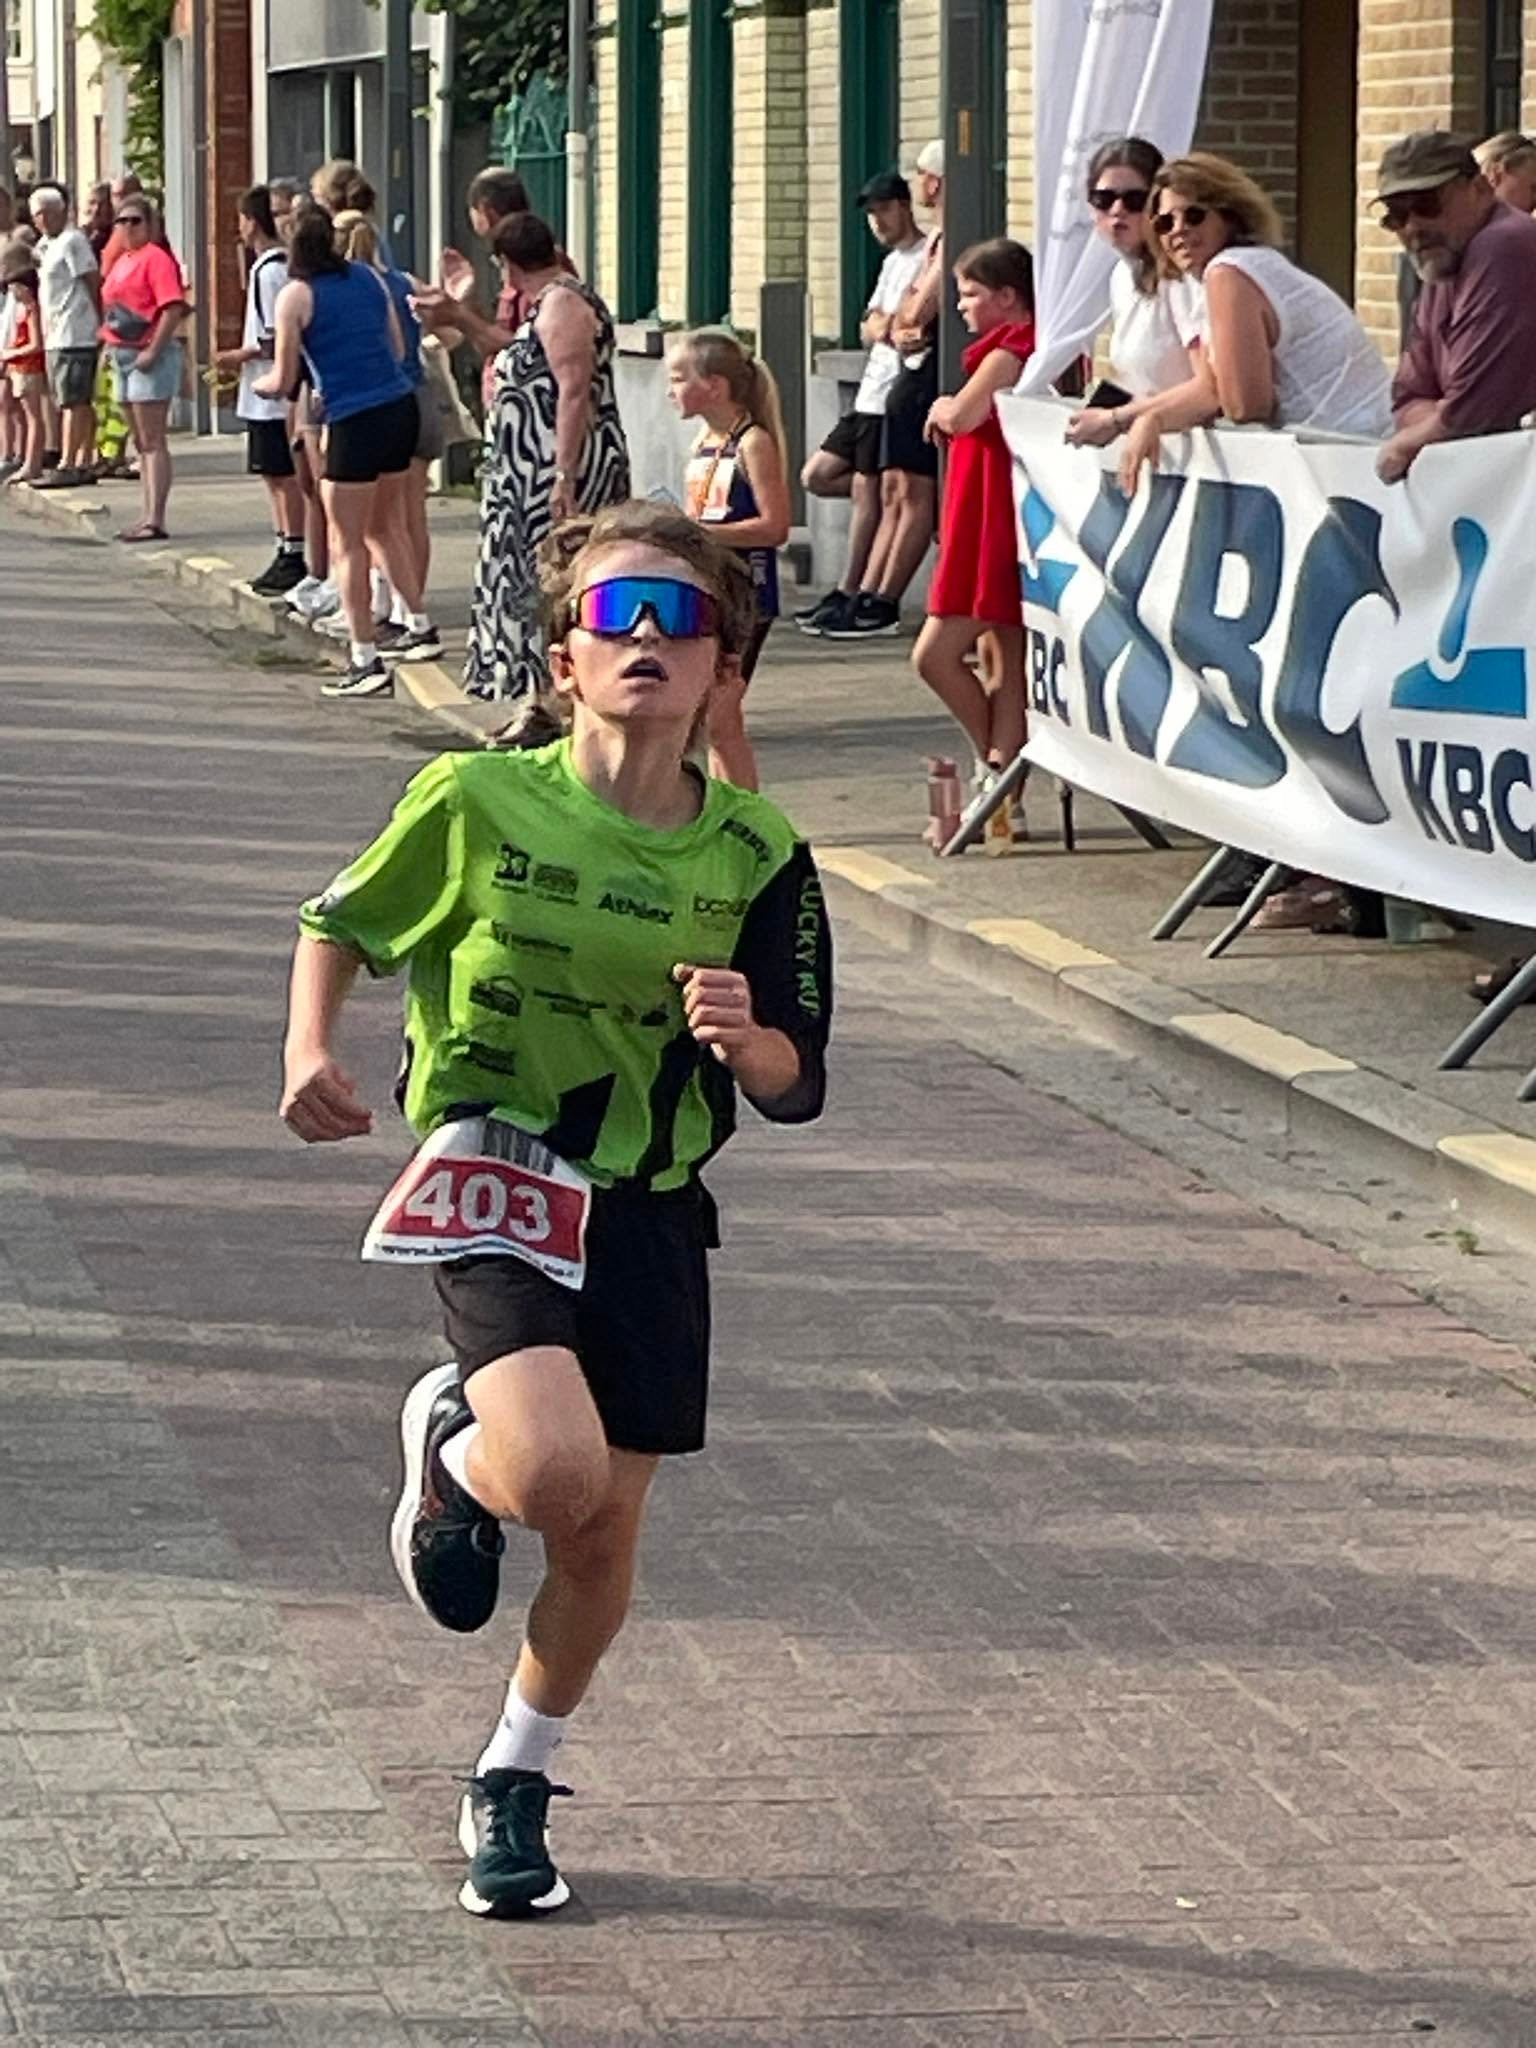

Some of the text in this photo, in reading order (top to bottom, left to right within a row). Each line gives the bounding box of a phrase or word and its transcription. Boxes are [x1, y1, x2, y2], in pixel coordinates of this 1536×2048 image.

[1022, 627, 1071, 727] BC
[1079, 469, 1400, 824] KBC
[1396, 738, 1536, 862] KBC
[405, 1170, 551, 1241] 403
